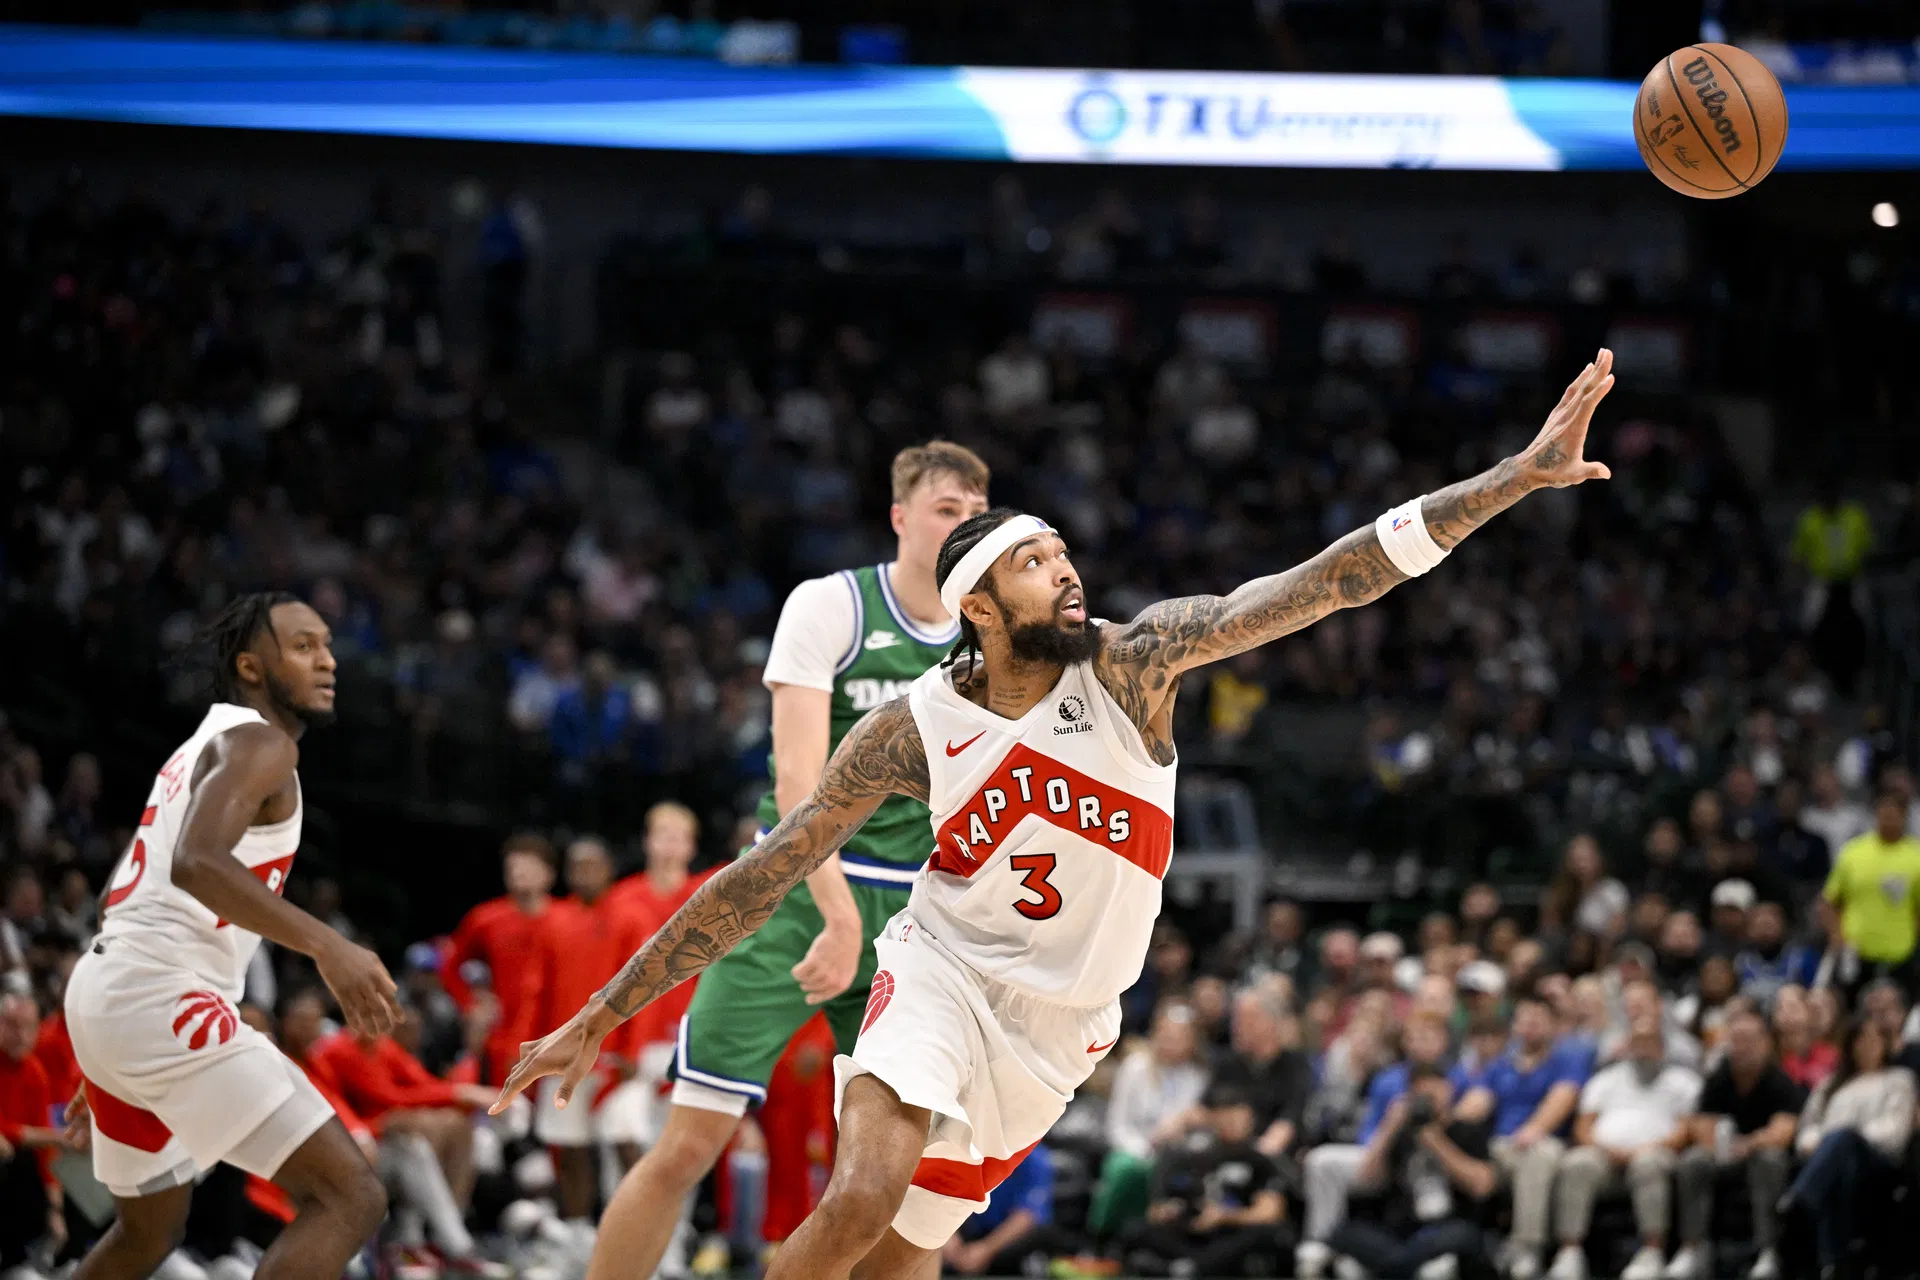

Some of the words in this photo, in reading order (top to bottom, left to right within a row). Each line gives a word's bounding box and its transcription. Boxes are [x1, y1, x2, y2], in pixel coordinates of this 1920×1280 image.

[1682, 56, 1741, 155] Wilson
[1053, 725, 1073, 736] Sun
[1074, 721, 1094, 733] Life
[950, 766, 1131, 862] RAPTORS
[1010, 853, 1063, 920] 3
